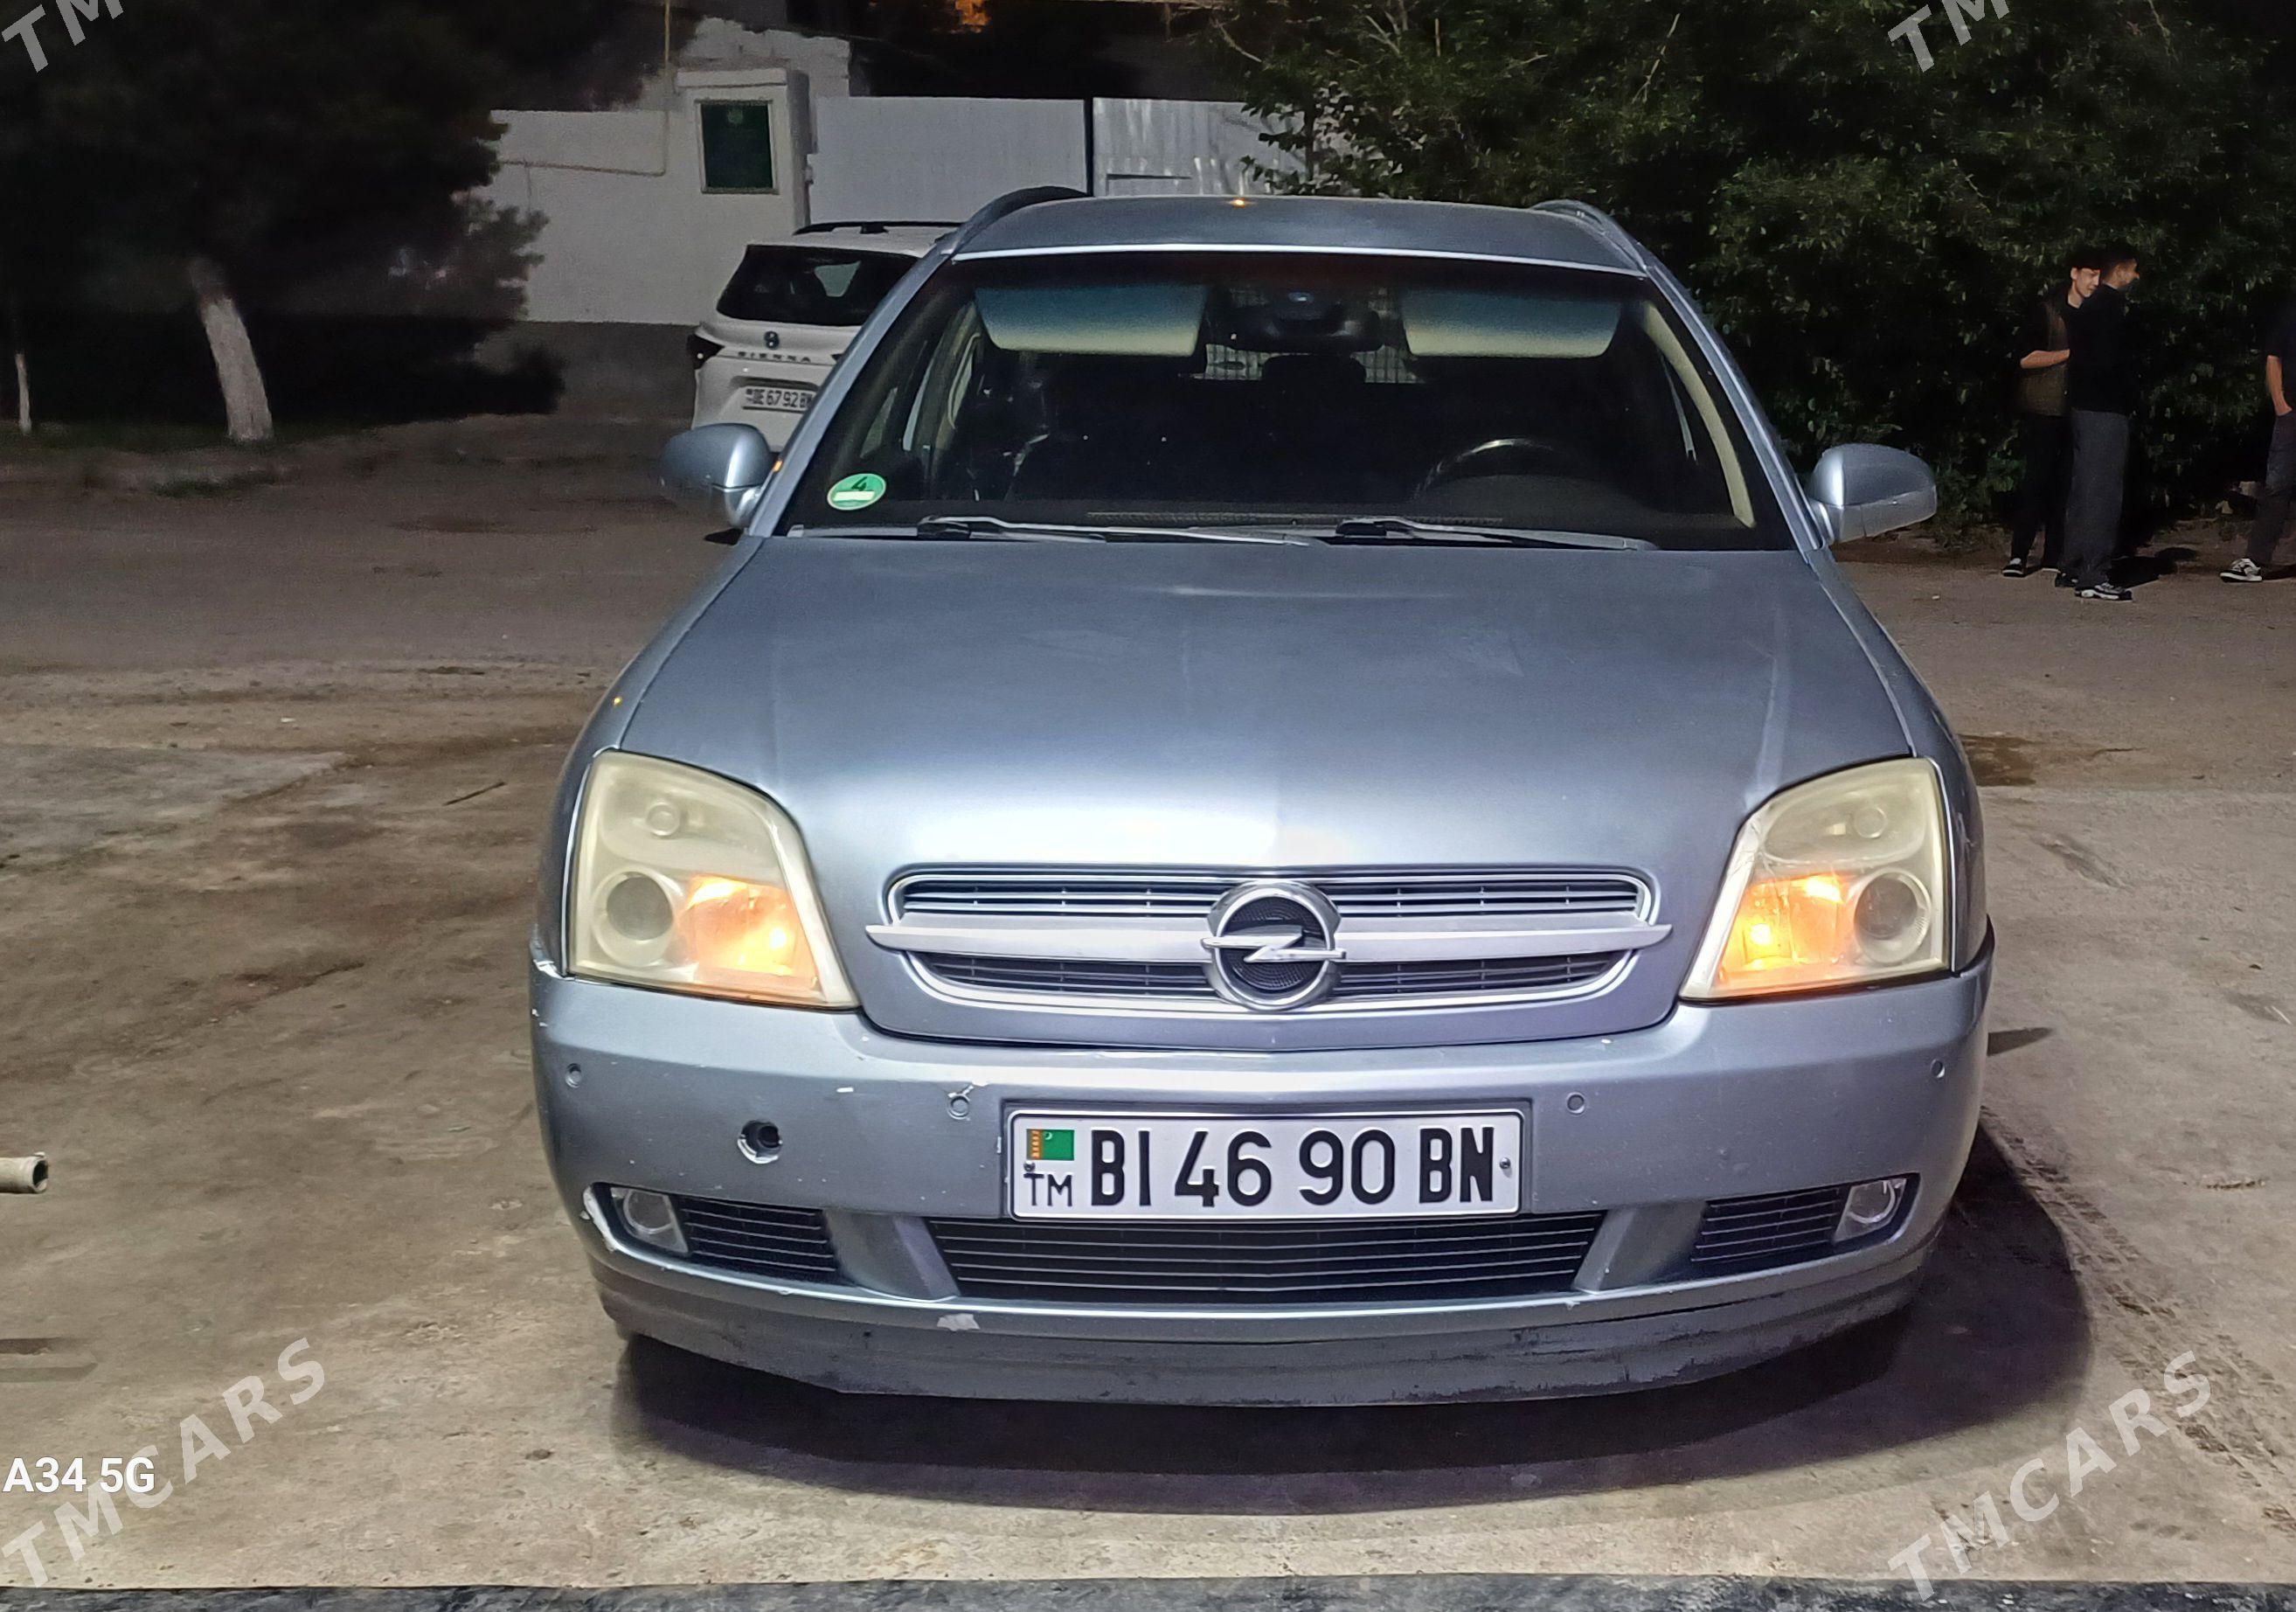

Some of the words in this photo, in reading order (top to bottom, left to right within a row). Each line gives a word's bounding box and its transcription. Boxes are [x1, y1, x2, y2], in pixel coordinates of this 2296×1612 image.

[766, 390, 781, 406] 67
[783, 392, 799, 408] 92
[851, 476, 868, 492] 4
[1091, 1129, 1151, 1206] BI
[1174, 1129, 1273, 1206] 46
[1299, 1128, 1397, 1205] 90
[1419, 1126, 1495, 1203] BN
[1023, 1172, 1073, 1206] TM
